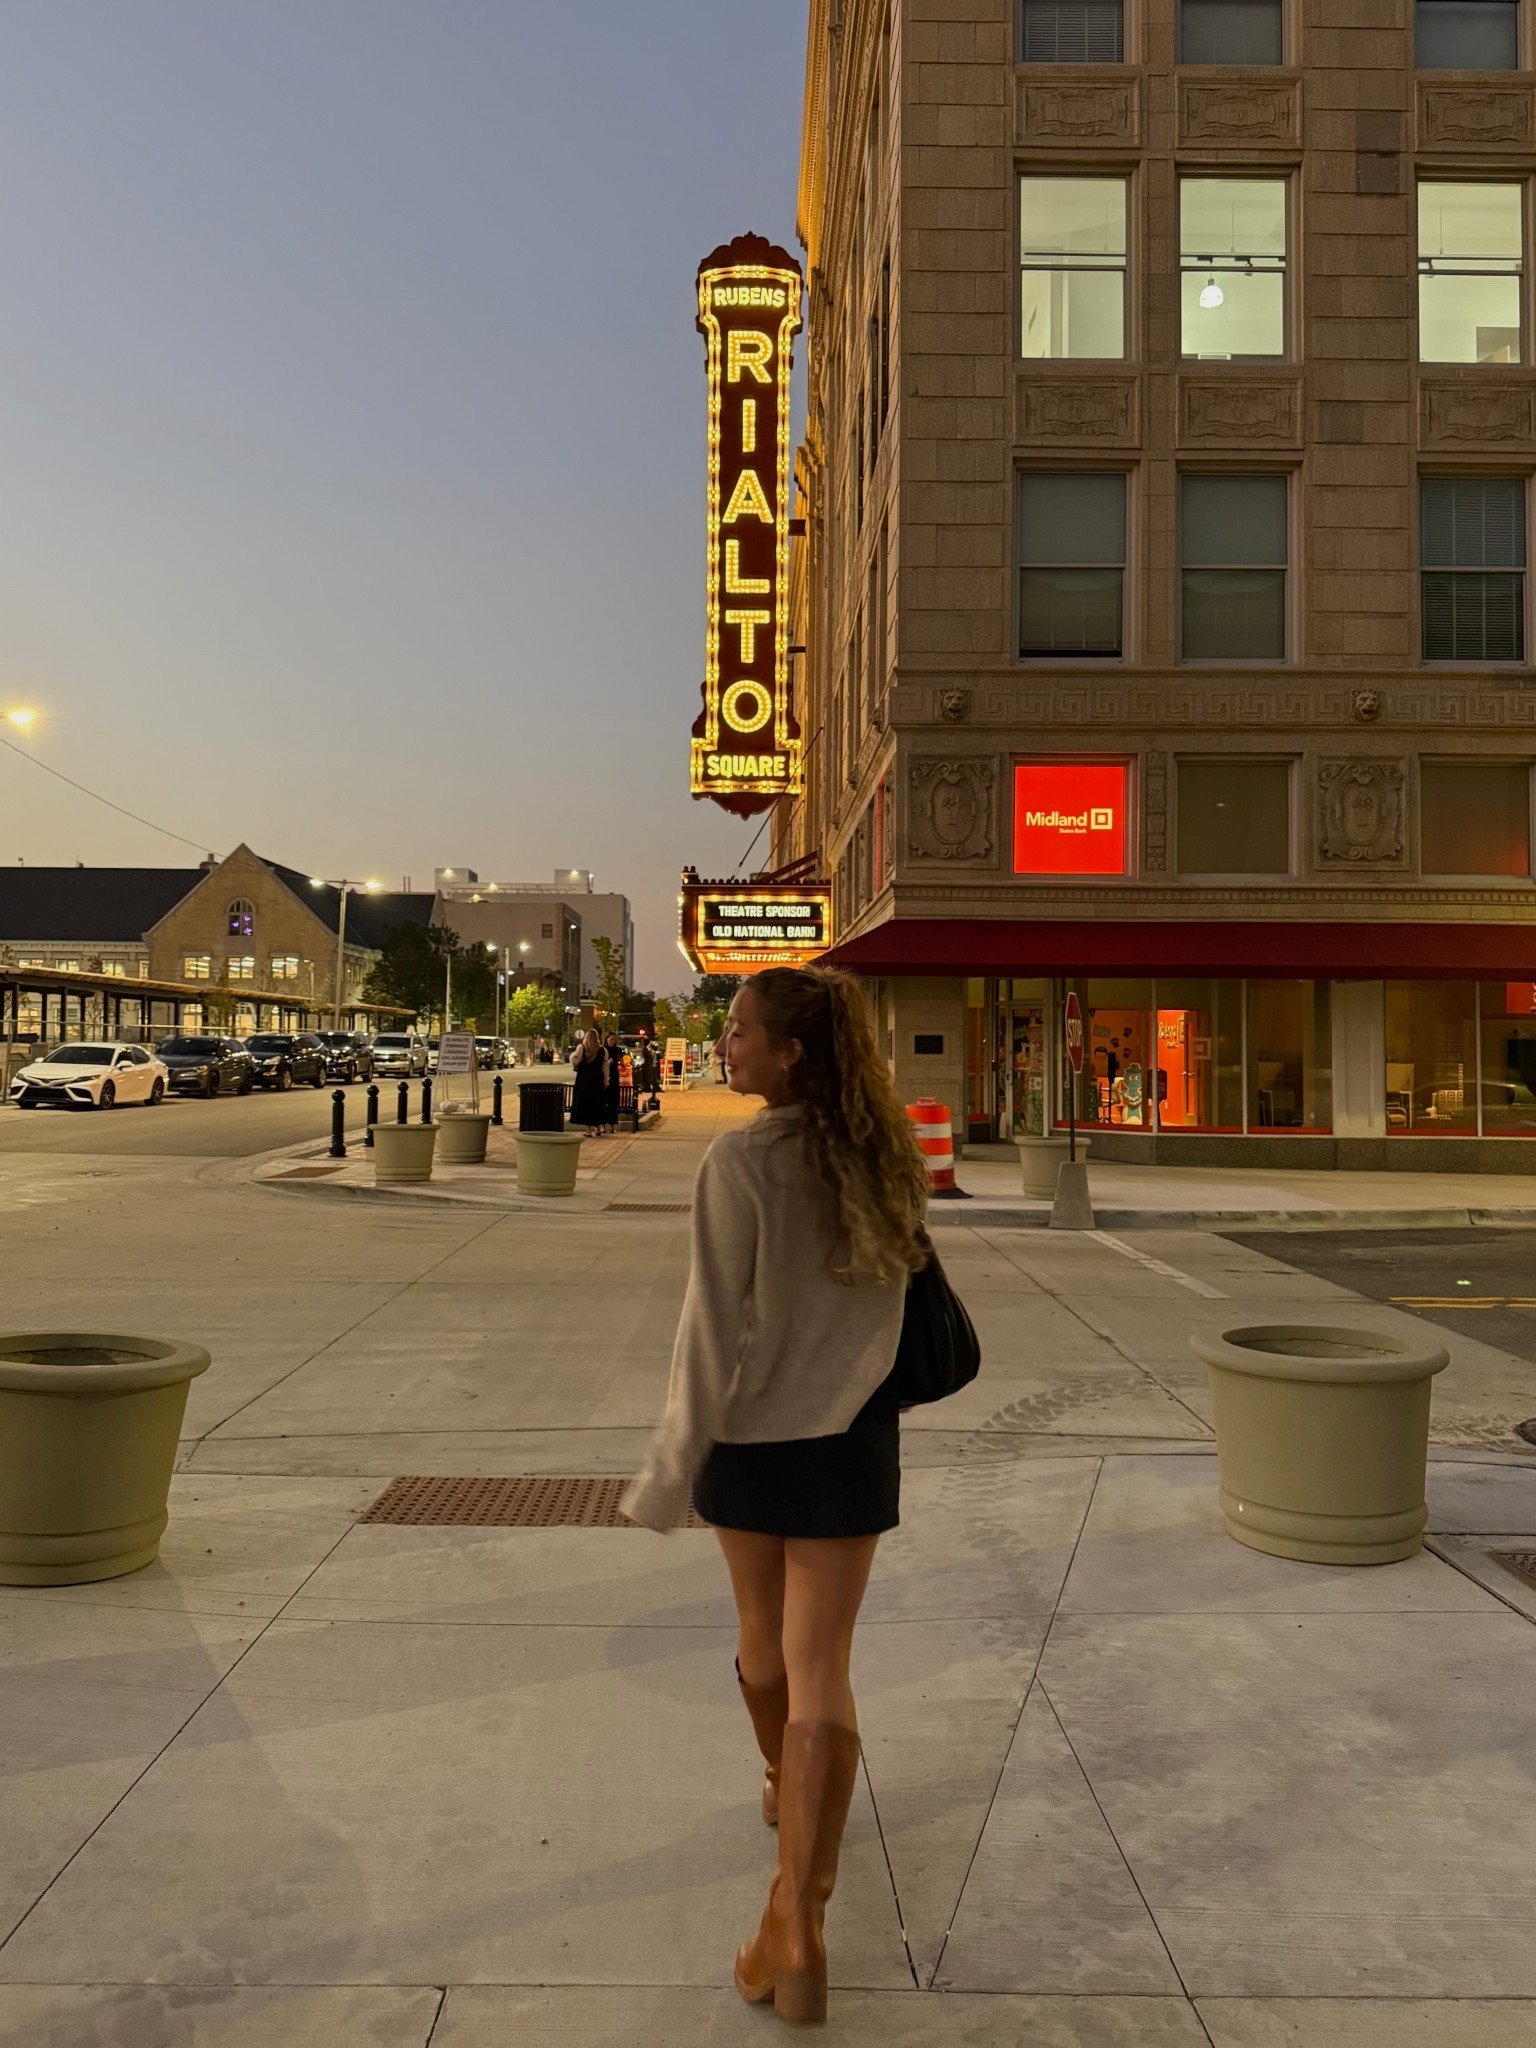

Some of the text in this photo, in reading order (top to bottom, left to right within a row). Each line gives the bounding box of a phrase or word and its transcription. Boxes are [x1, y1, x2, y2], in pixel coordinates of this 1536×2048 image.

[713, 286, 785, 307] RUBENS
[722, 330, 774, 733] RIALTO
[707, 755, 786, 778] SQUARE
[1025, 811, 1087, 827] Midland
[718, 905, 763, 917] THEATRE
[712, 925, 732, 937] OLD
[733, 925, 784, 938] NATIONAL
[1067, 1018, 1082, 1048] STOP
